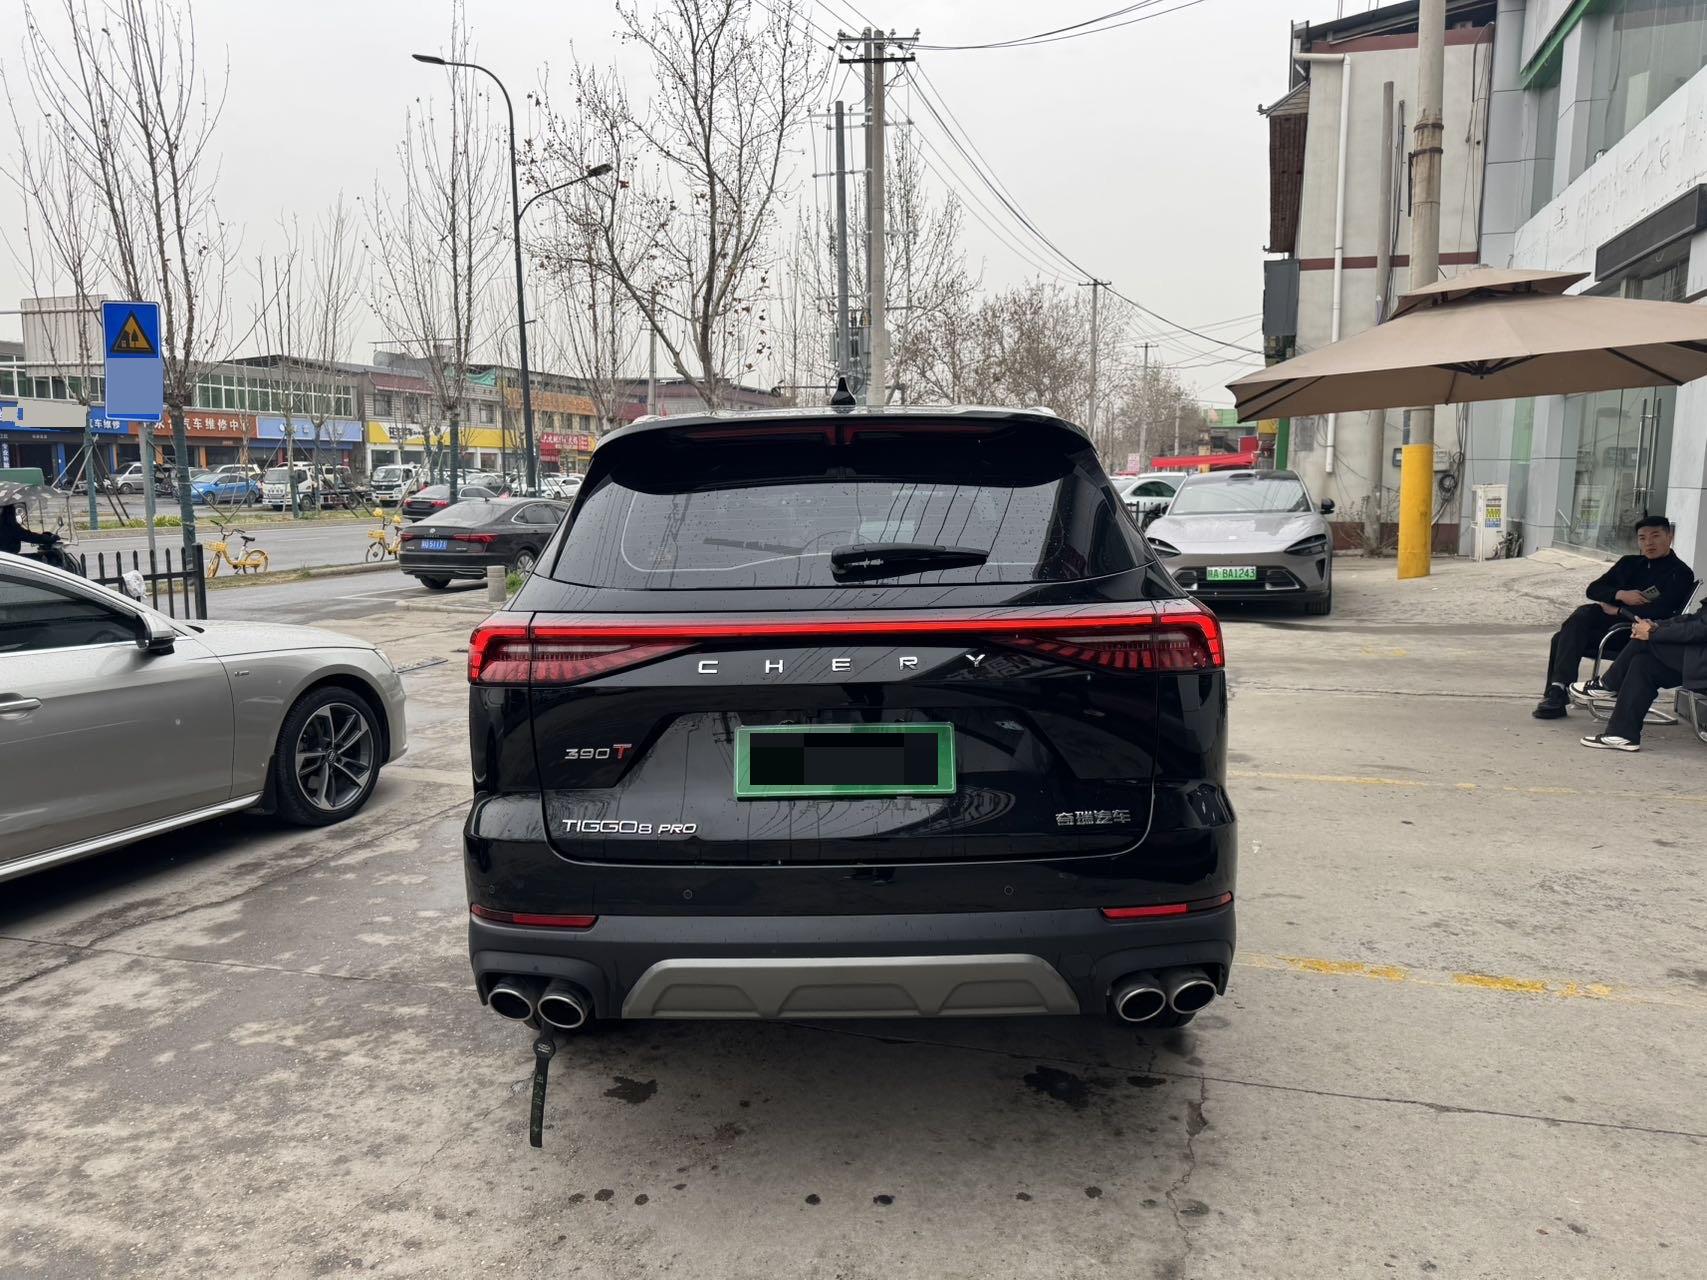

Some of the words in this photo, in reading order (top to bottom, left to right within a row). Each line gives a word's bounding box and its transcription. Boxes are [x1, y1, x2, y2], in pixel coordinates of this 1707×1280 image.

[698, 654, 985, 674] CHERY
[564, 743, 632, 760] 390T
[1055, 809, 1131, 826] 奇瑞汽车
[657, 823, 697, 834] PRO
